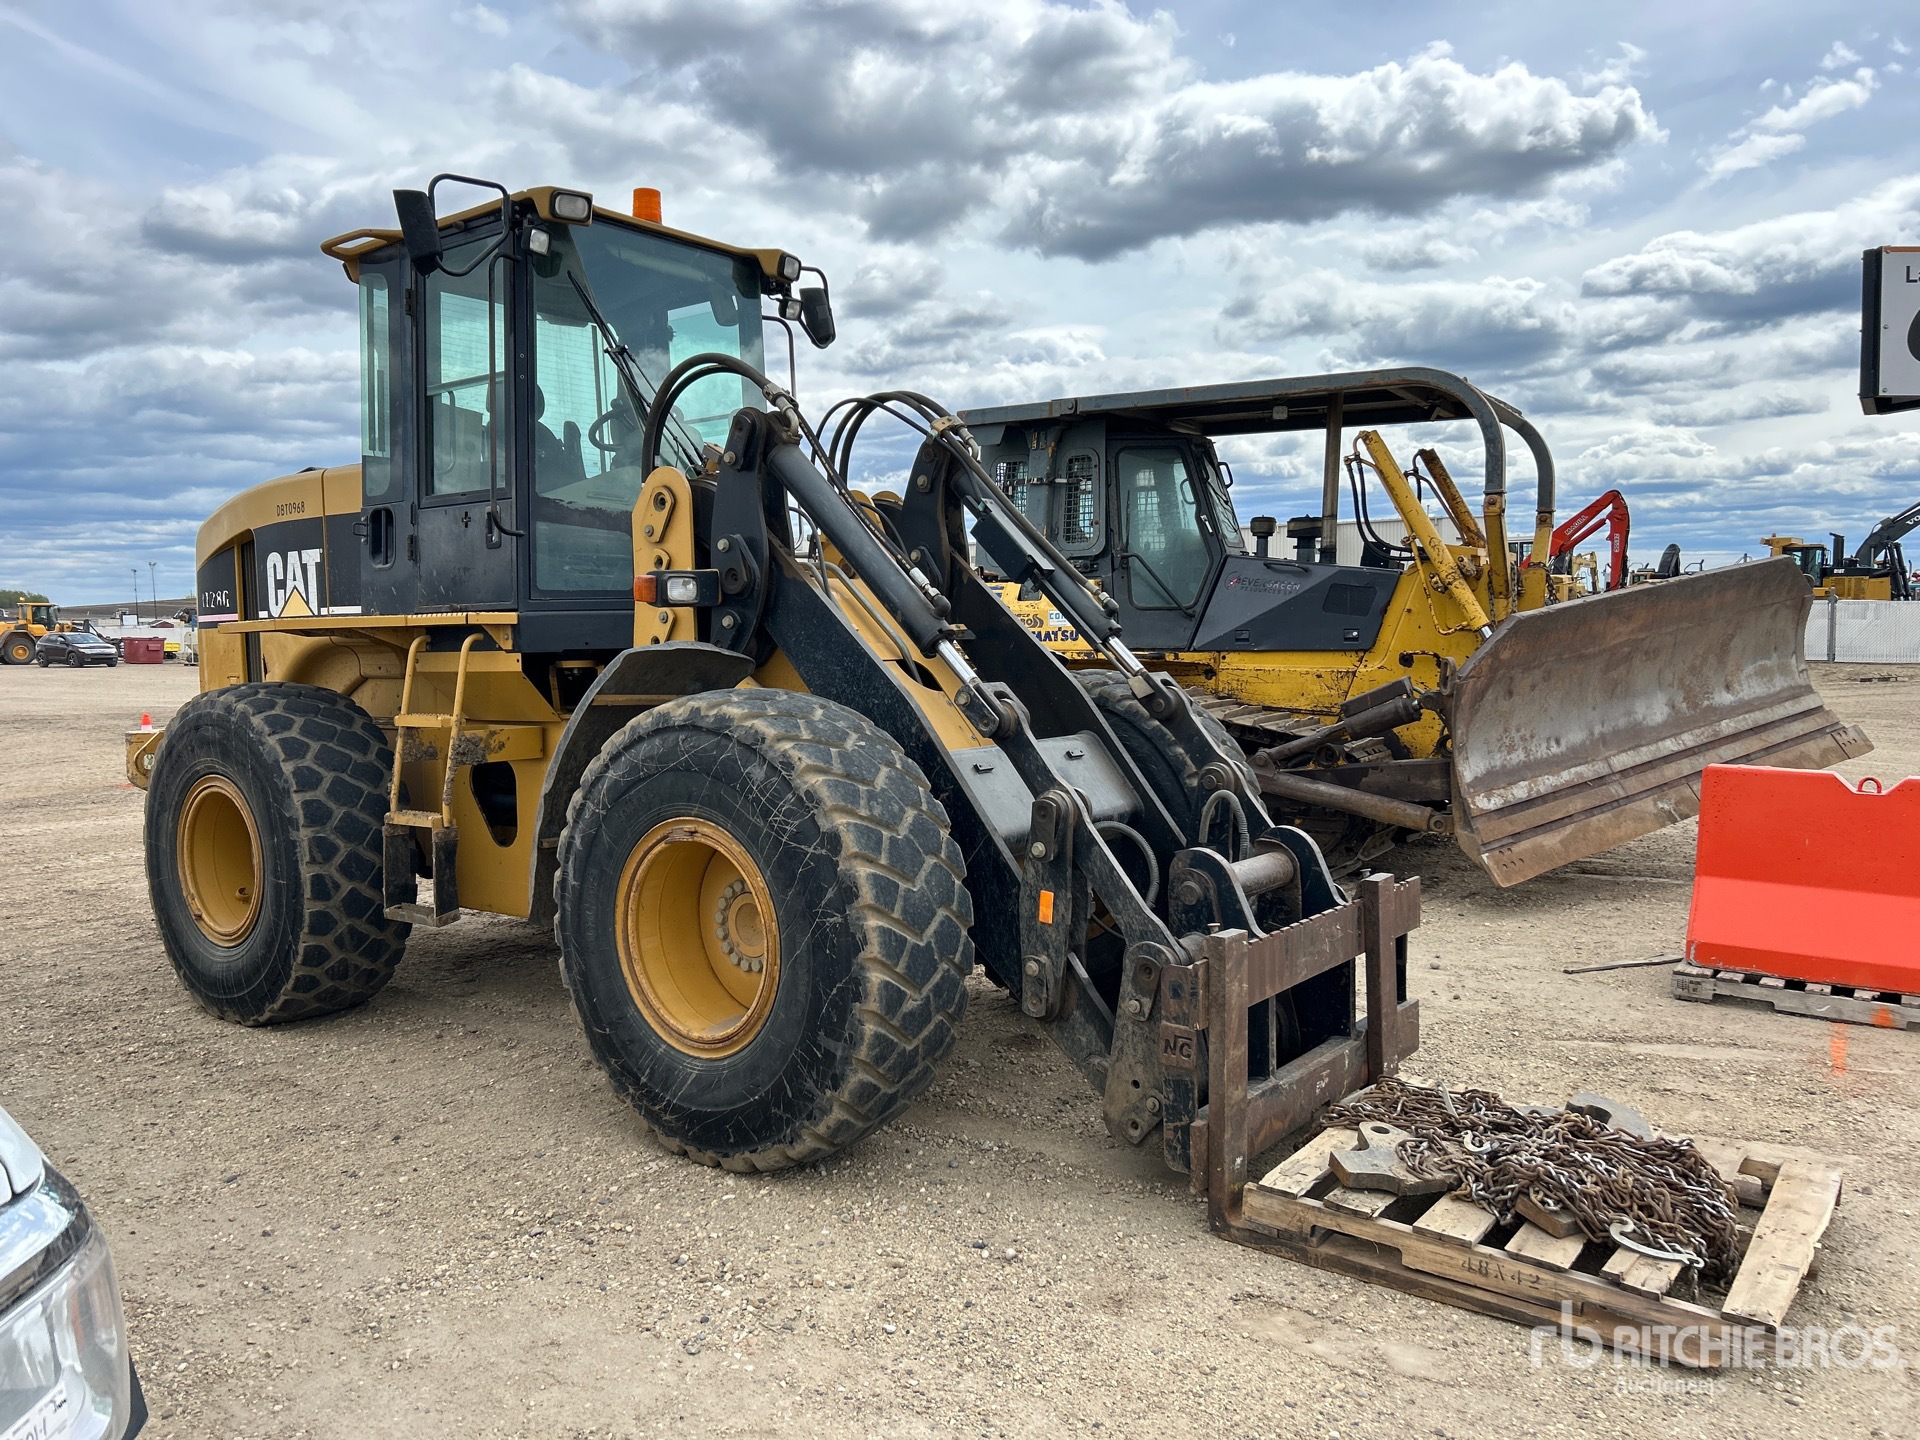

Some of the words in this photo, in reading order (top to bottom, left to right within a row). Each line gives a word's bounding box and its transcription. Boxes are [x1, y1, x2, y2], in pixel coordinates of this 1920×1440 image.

[276, 501, 305, 517] DBT0968
[266, 548, 321, 618] CAT
[1031, 628, 1080, 642] MATSU
